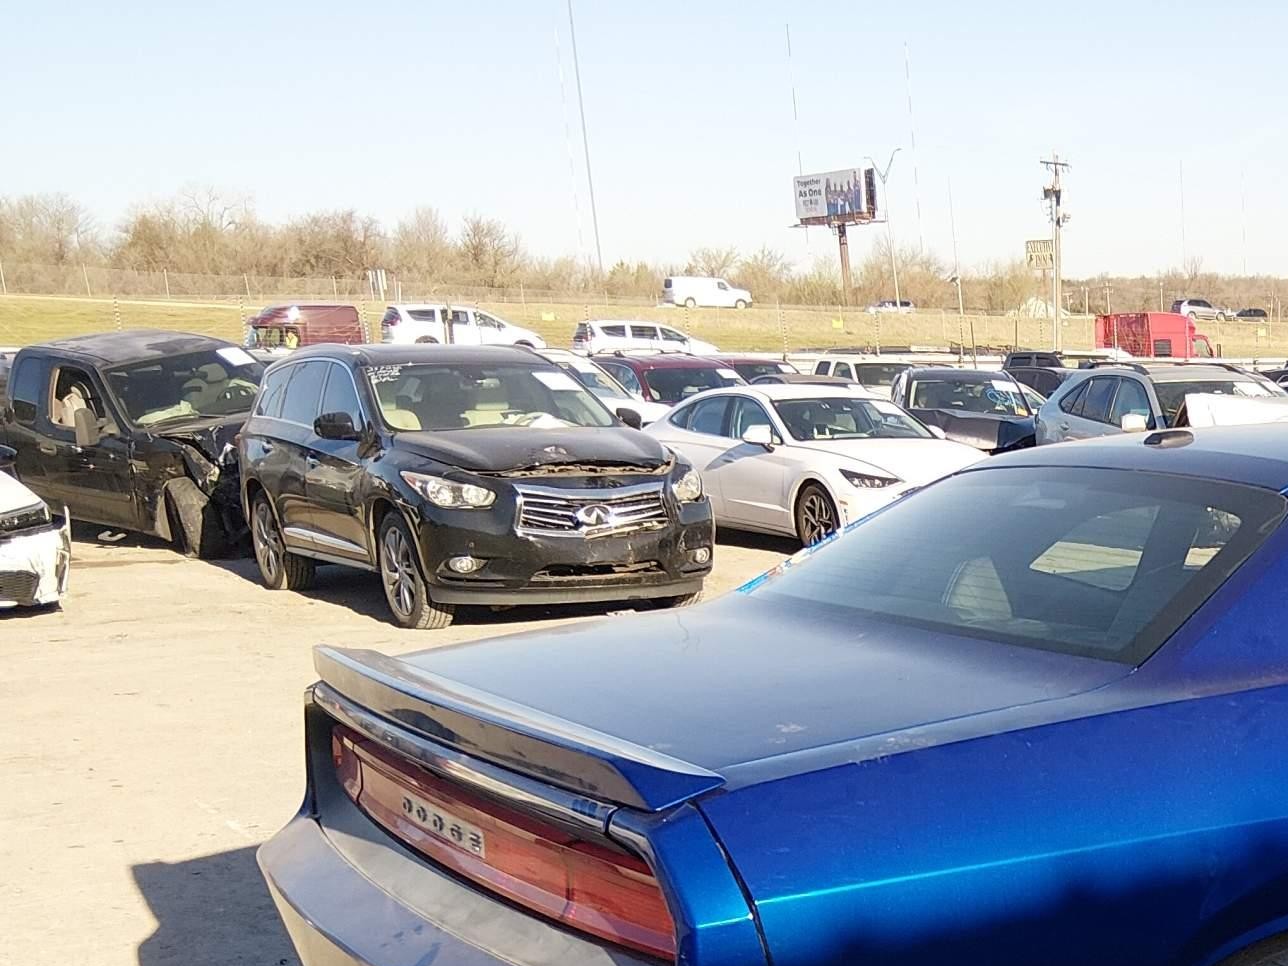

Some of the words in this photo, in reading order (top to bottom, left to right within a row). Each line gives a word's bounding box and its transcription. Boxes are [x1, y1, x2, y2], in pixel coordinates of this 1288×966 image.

[797, 178, 821, 188] Together
[798, 190, 808, 198] As
[808, 188, 822, 197] One
[1035, 254, 1048, 267] INN
[402, 797, 482, 853] DODGE
